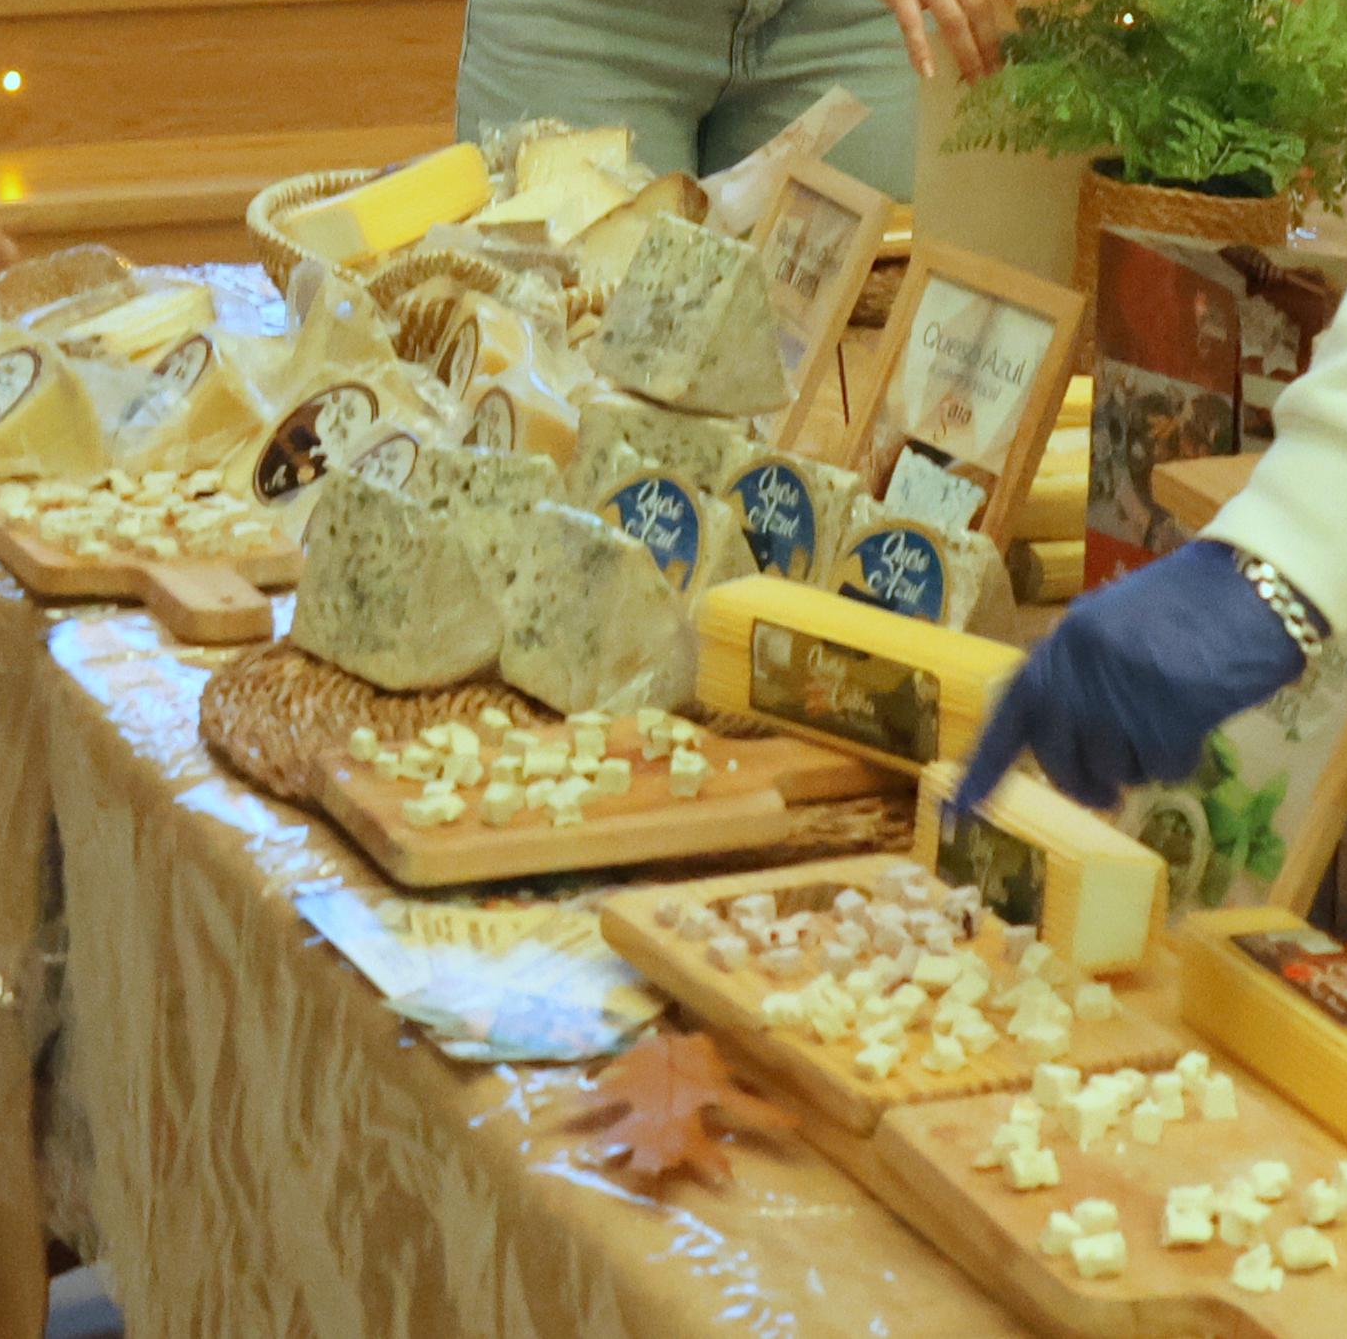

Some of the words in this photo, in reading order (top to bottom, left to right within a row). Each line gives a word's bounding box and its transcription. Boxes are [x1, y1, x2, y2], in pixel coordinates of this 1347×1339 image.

[980, 344, 1026, 385] Azul
[635, 480, 685, 521] Queso
[757, 467, 800, 507] Queso
[625, 517, 682, 551] Azul
[748, 503, 800, 539] Azul
[881, 530, 930, 573] Queso
[868, 564, 927, 604] Azul
